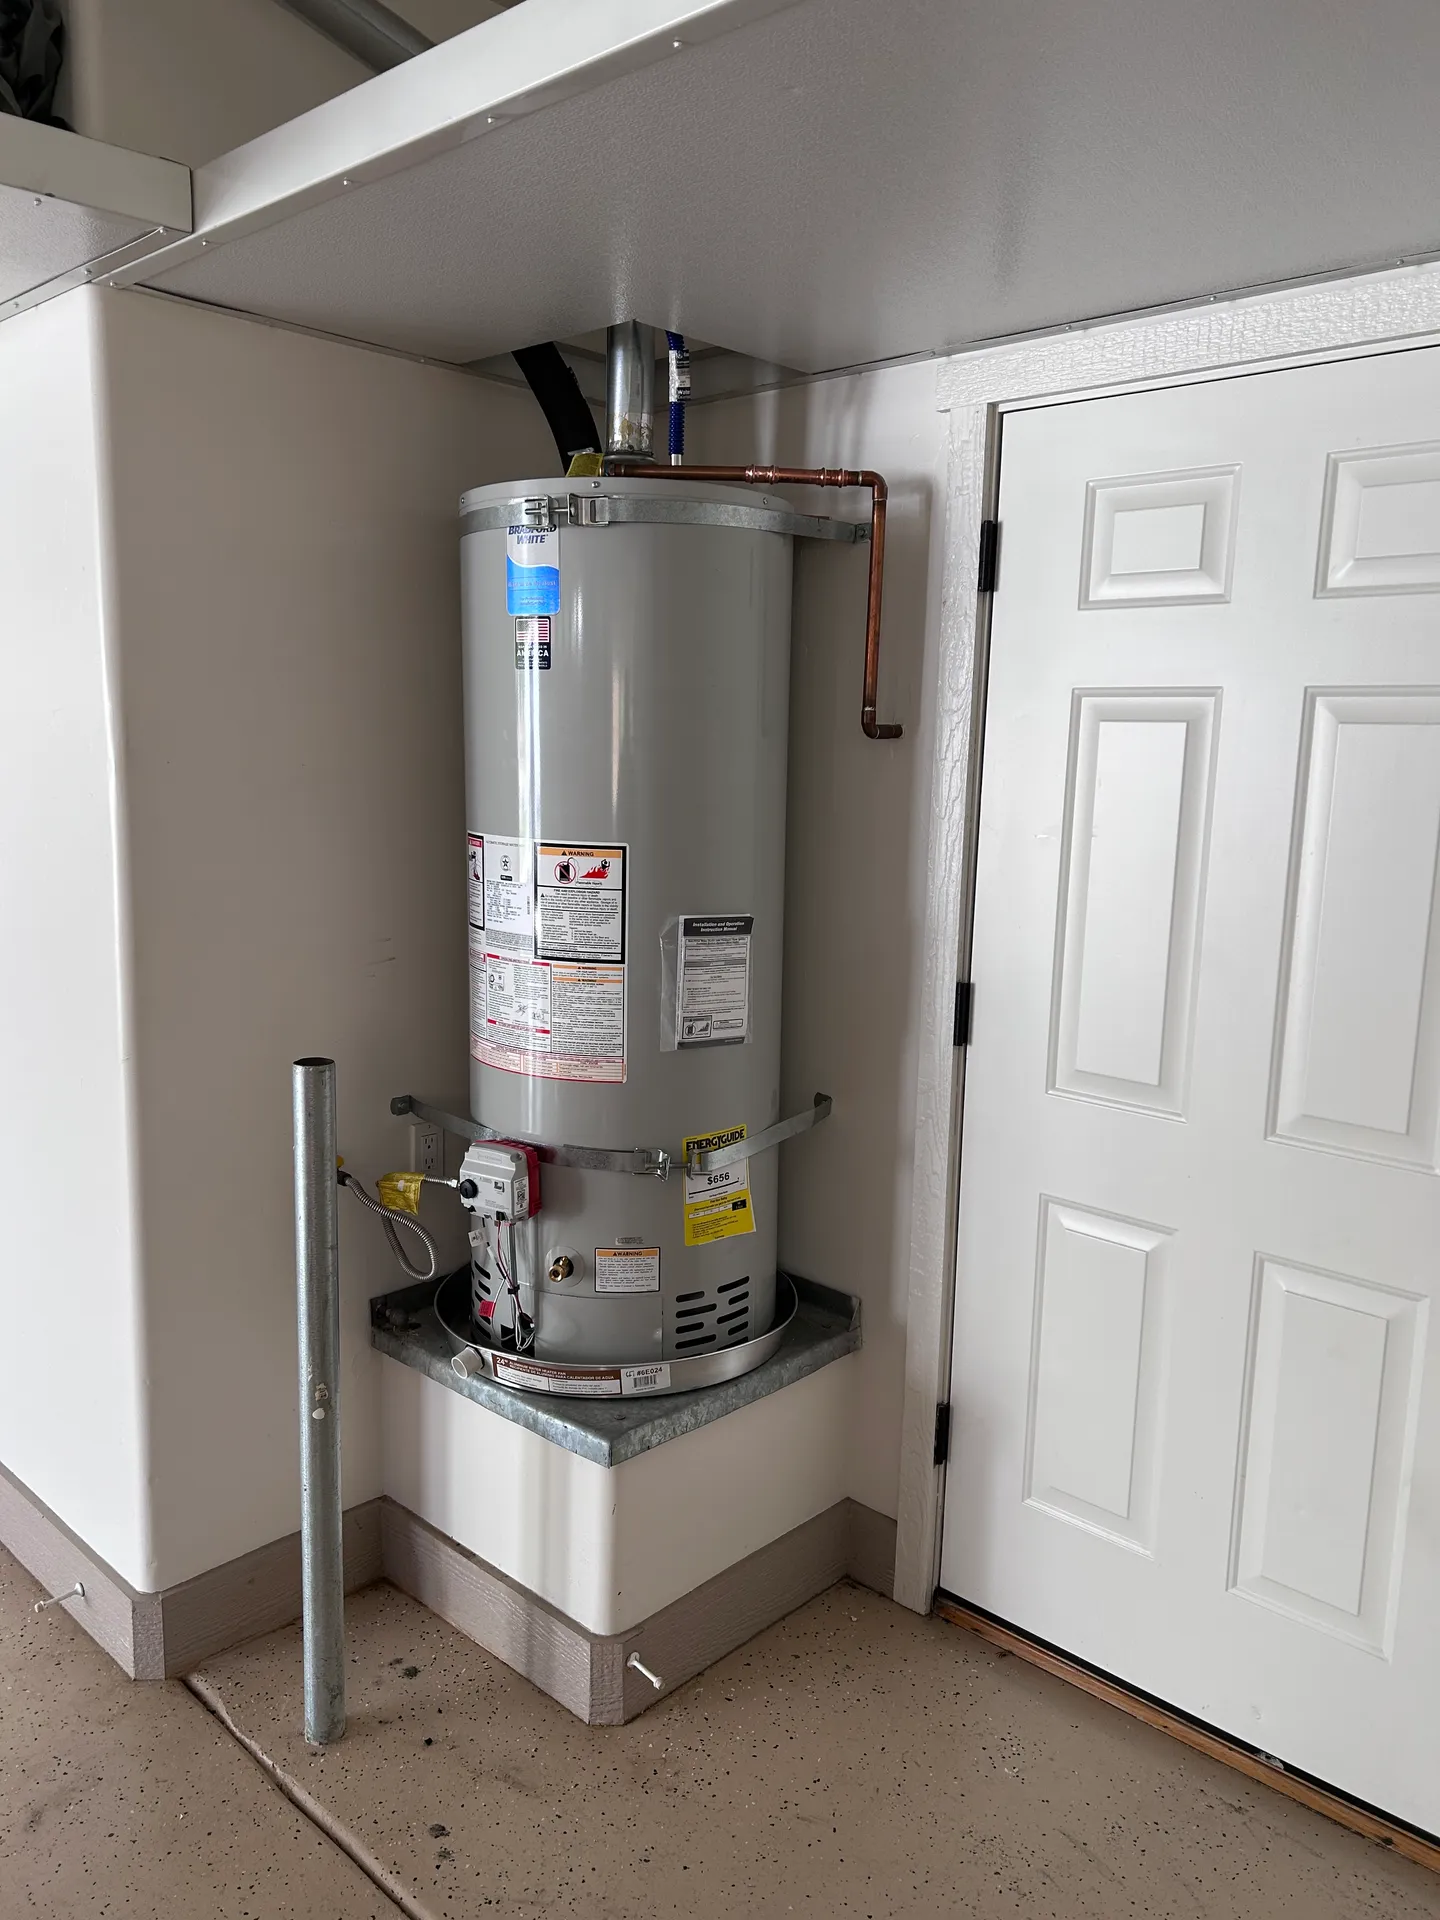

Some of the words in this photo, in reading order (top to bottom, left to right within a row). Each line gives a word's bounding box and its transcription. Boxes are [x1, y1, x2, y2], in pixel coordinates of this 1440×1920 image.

[517, 534, 546, 544] WHITE
[686, 1128, 745, 1152] ENERGYGUIDE
[707, 1172, 730, 1186] $656
